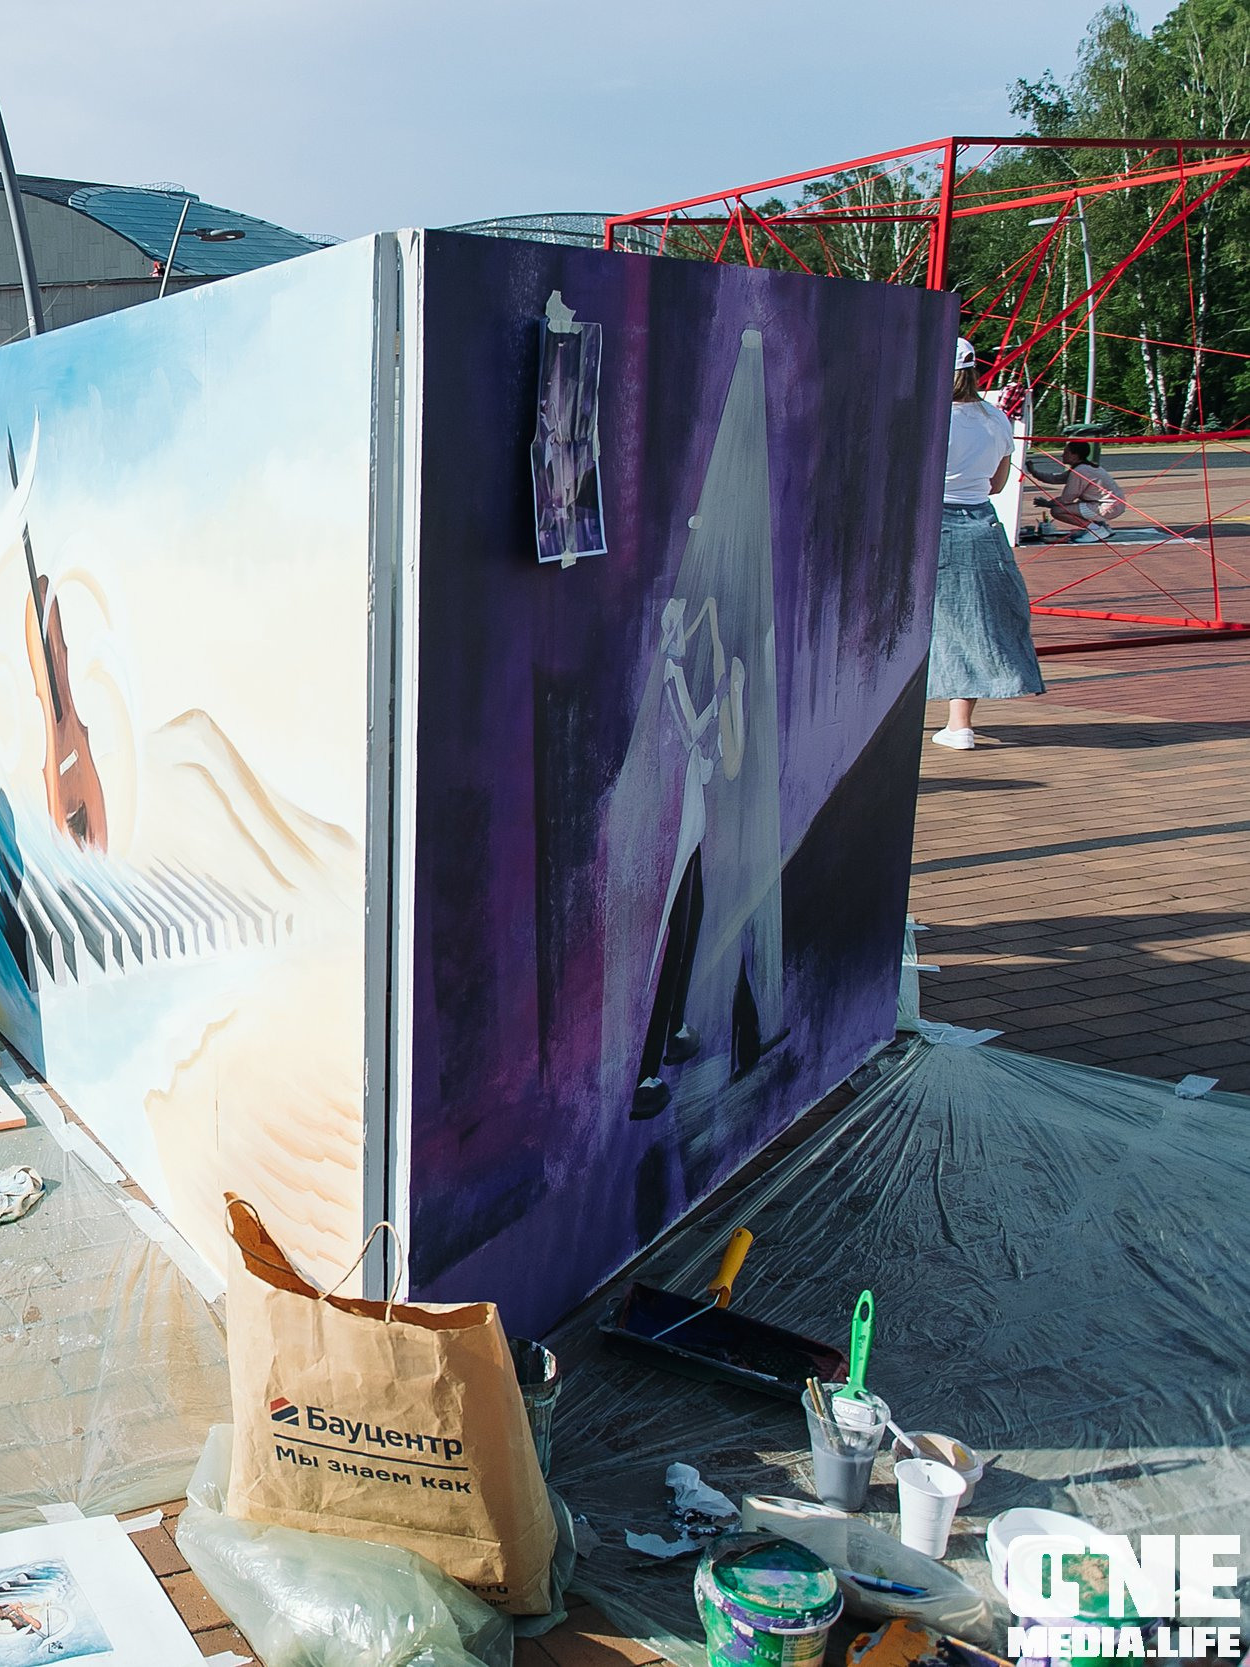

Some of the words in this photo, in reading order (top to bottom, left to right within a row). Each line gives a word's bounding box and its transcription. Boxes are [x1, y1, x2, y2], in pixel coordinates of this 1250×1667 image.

[306, 1405, 464, 1461] Бауцентр
[275, 1445, 319, 1467] Мы
[327, 1459, 412, 1485] знаем
[421, 1476, 471, 1494] как
